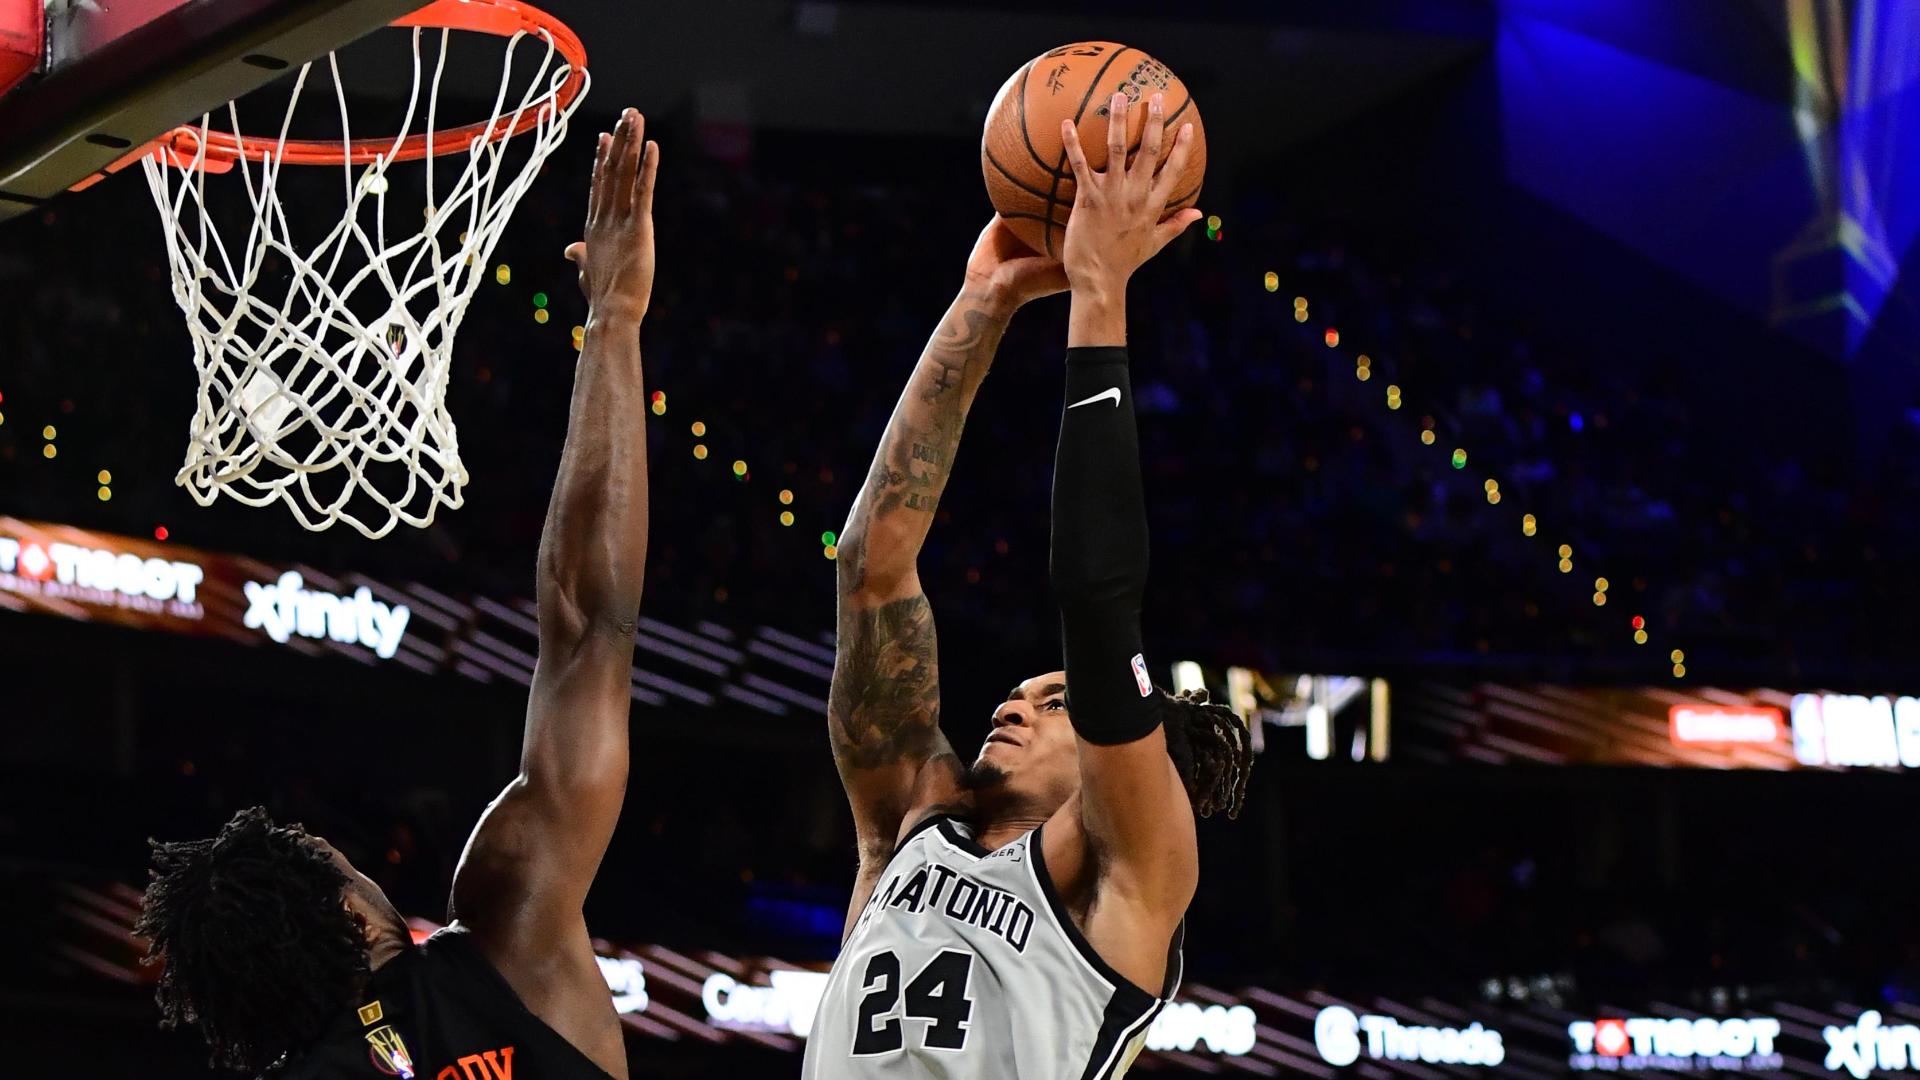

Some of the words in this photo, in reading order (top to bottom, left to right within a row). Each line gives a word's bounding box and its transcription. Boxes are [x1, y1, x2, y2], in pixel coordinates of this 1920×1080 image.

[48, 542, 203, 603] TISSOT
[244, 571, 409, 657] xfinity
[849, 948, 975, 1058] 24
[1359, 1014, 1504, 1066] Threads
[1625, 1016, 1781, 1058] TISSOT
